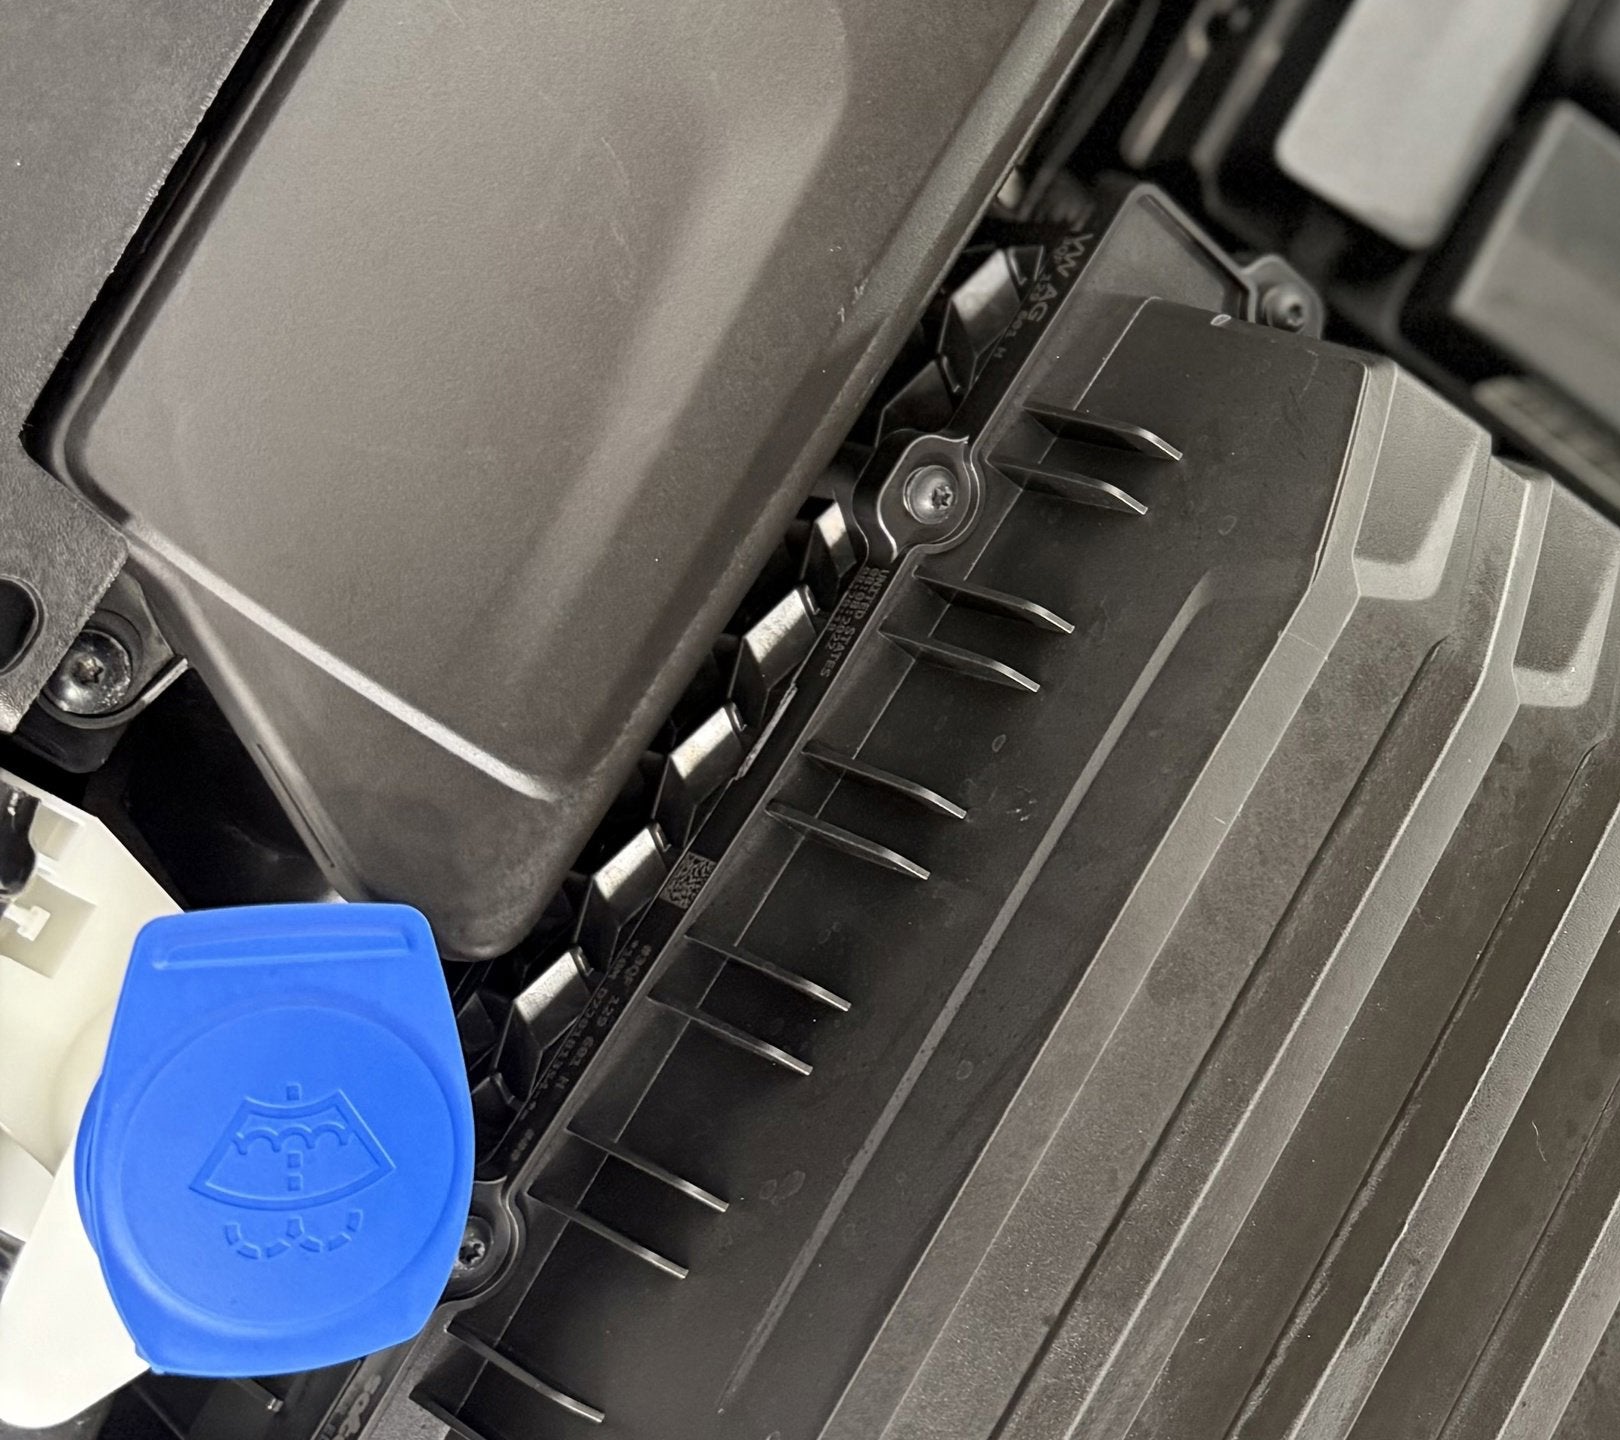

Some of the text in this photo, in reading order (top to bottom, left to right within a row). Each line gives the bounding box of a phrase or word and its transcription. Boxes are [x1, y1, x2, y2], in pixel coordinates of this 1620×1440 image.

[1025, 232, 1094, 322] VW AG
[855, 570, 891, 618] UNITED
[817, 625, 858, 677] STATES
